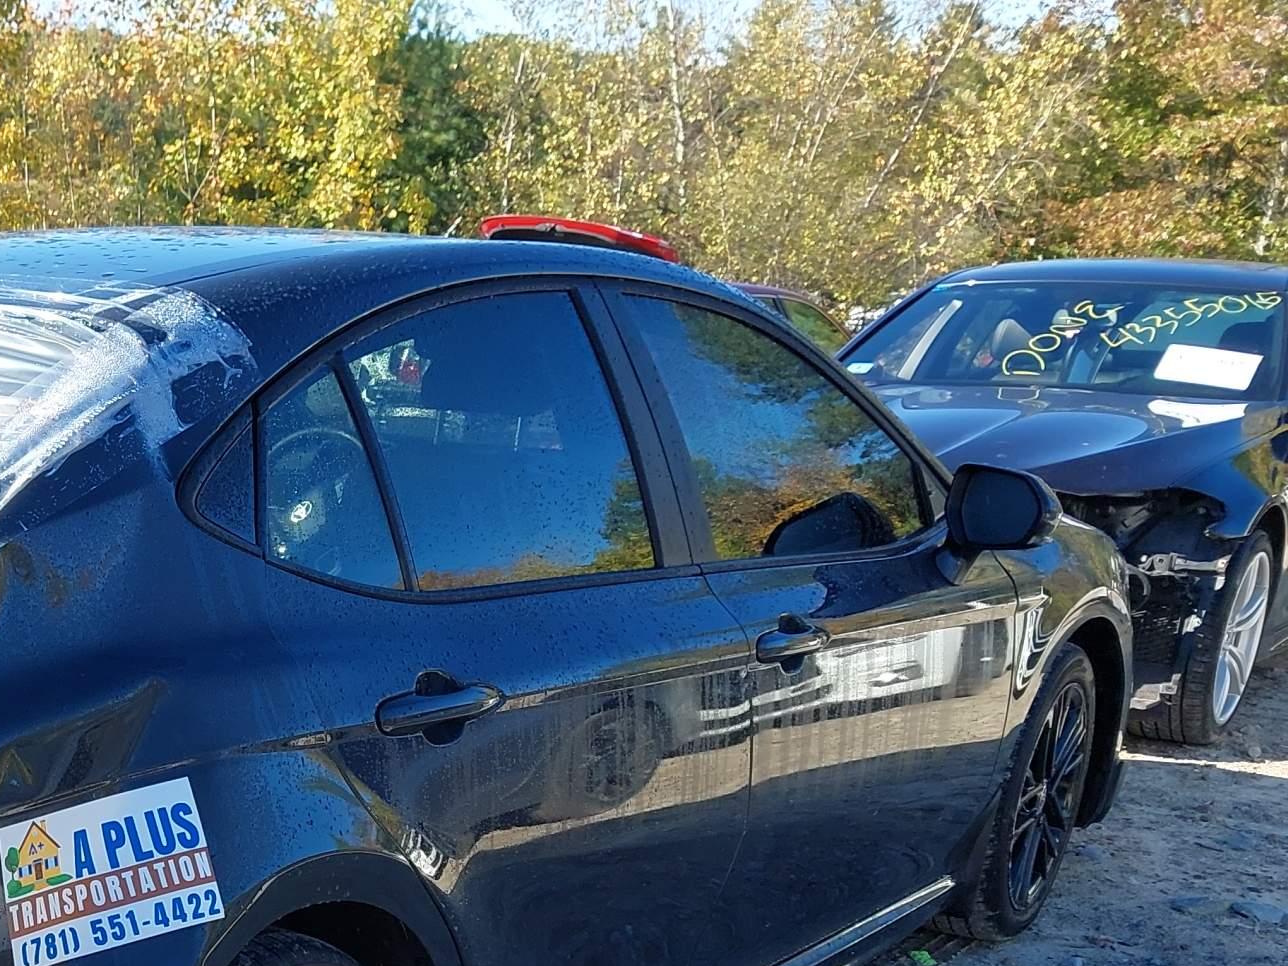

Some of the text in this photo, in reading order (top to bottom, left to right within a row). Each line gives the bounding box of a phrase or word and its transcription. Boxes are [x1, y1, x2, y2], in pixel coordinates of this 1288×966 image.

[73, 803, 200, 879] A PLUS
[10, 852, 213, 932] TRANSPORTATION
[21, 889, 221, 966] (781) 551-4422
